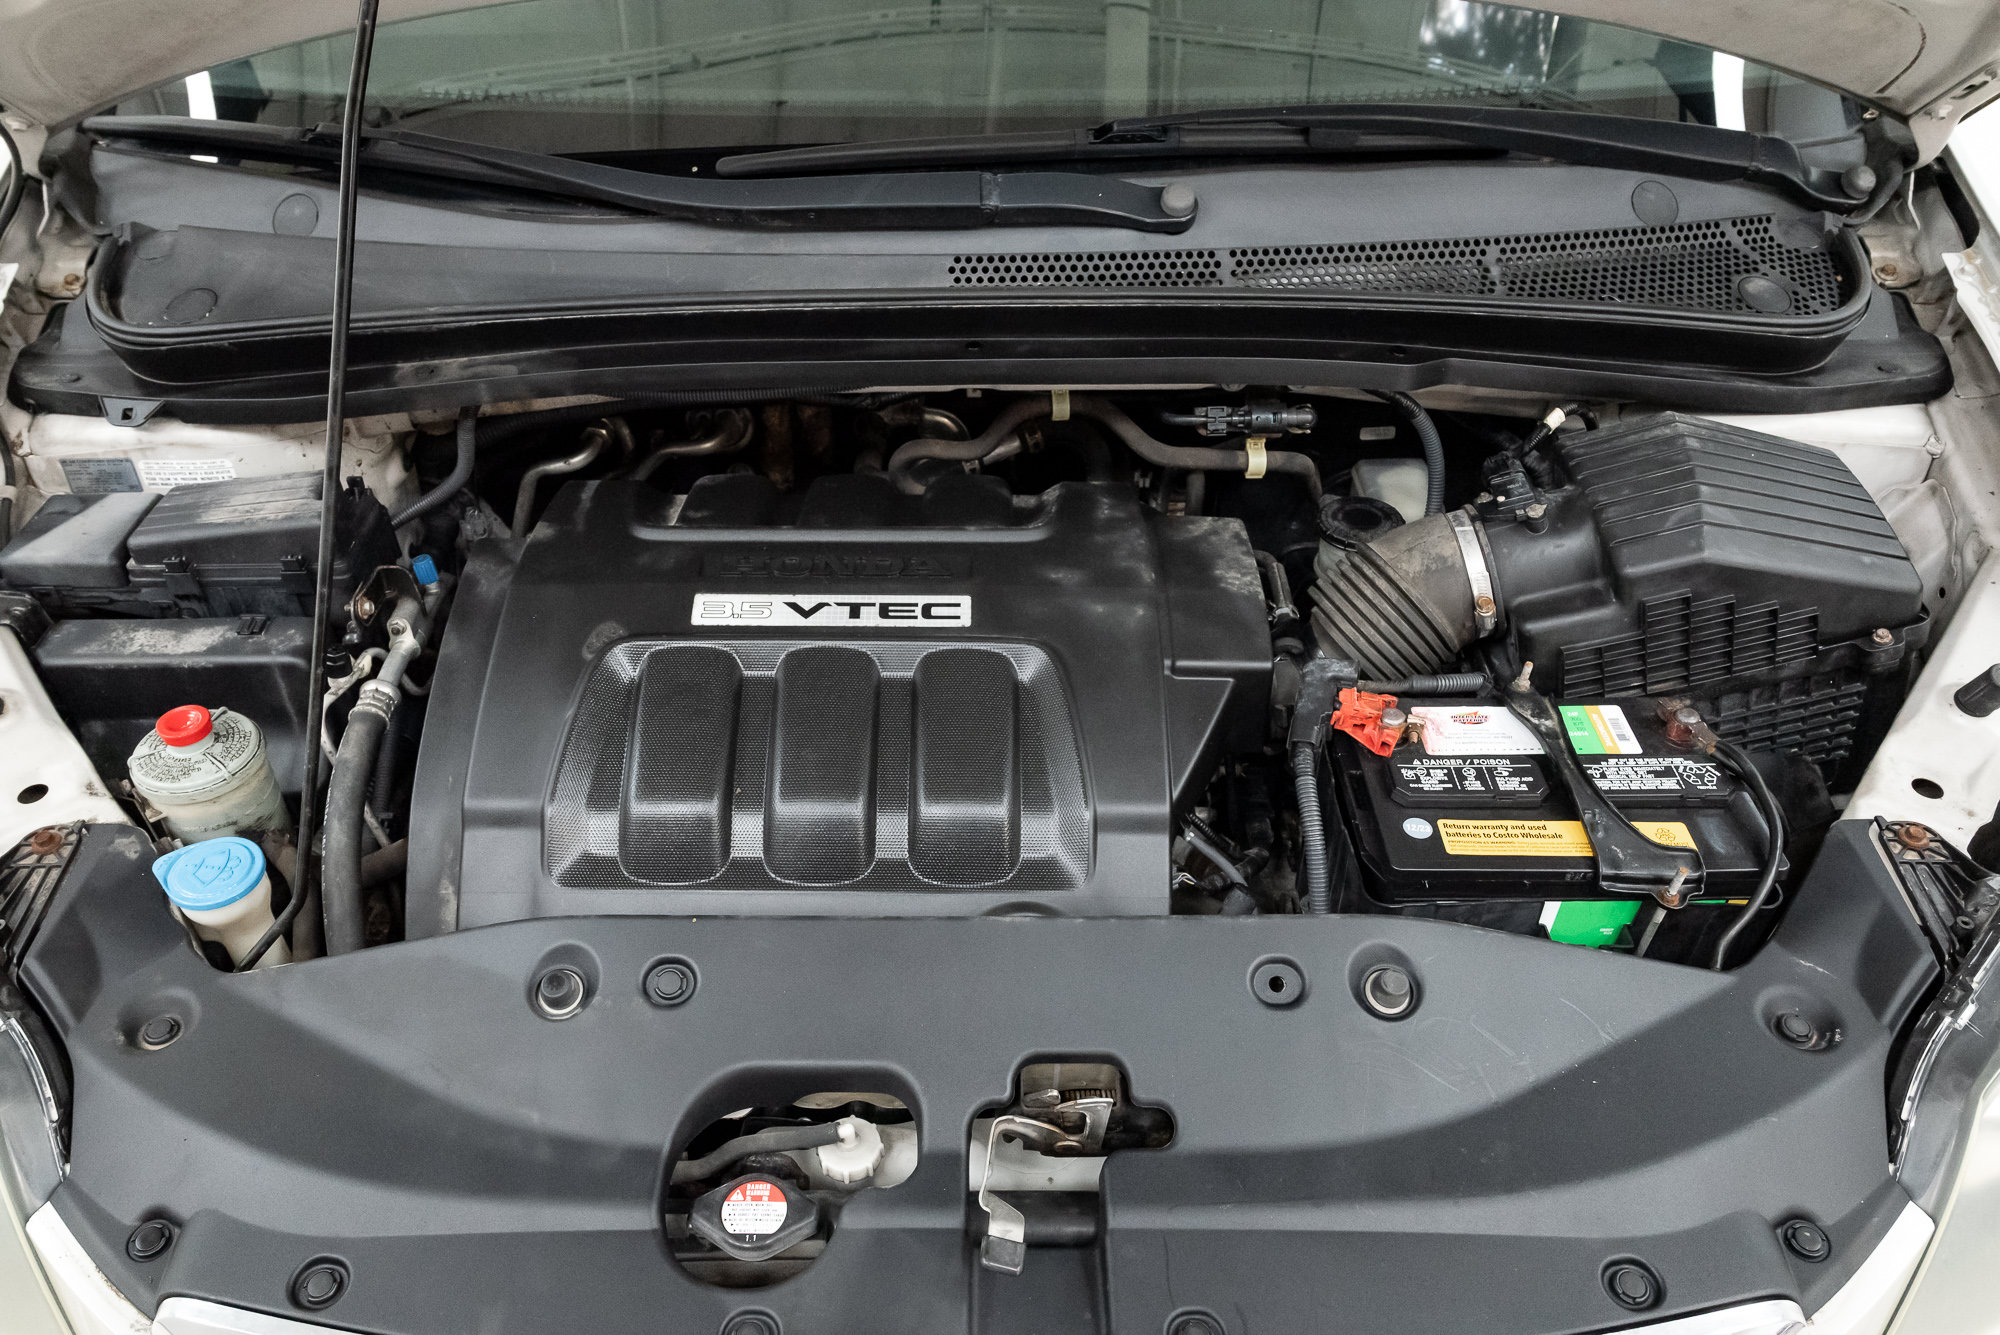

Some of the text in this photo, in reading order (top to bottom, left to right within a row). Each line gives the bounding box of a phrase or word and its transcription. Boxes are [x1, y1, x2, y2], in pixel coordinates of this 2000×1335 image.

[720, 553, 952, 579] HONDA
[700, 600, 963, 621] 3.5 VTEC
[1442, 822, 1471, 831] Return
[1471, 824, 1509, 832] warranty
[1510, 823, 1527, 831] and
[1445, 831, 1482, 839] batteries
[1520, 832, 1564, 840] Wholesale
[745, 1234, 757, 1242] 1.1
